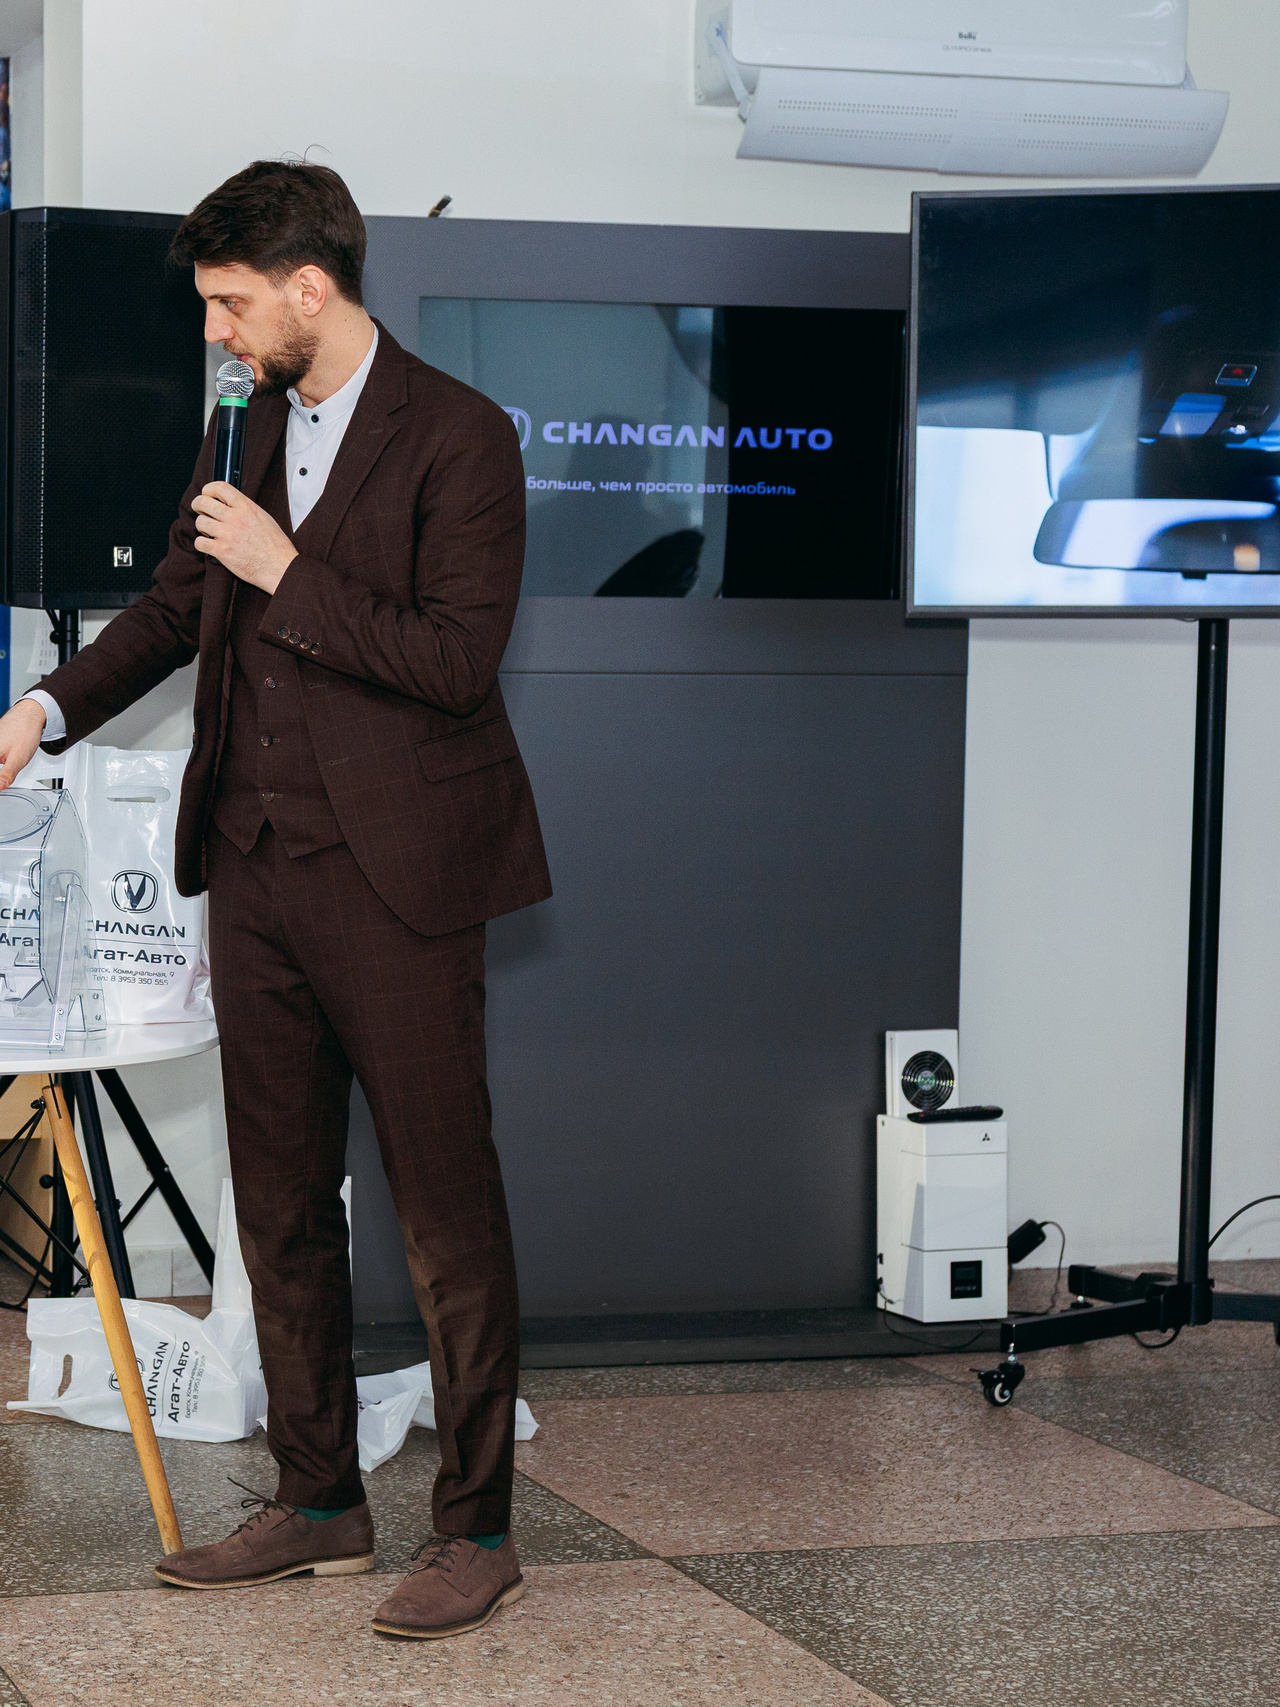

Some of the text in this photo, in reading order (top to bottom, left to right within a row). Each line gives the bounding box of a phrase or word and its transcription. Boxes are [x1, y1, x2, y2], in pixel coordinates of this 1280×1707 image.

[542, 421, 833, 451] CHANGAN AUTO
[526, 475, 797, 495] больше, чем просто автомобиль
[84, 965, 111, 974] ратск,
[113, 967, 168, 978] Коммунальная,
[138, 977, 152, 985] 350
[154, 978, 169, 986] 555
[168, 1341, 190, 1423] Агат-Авто
